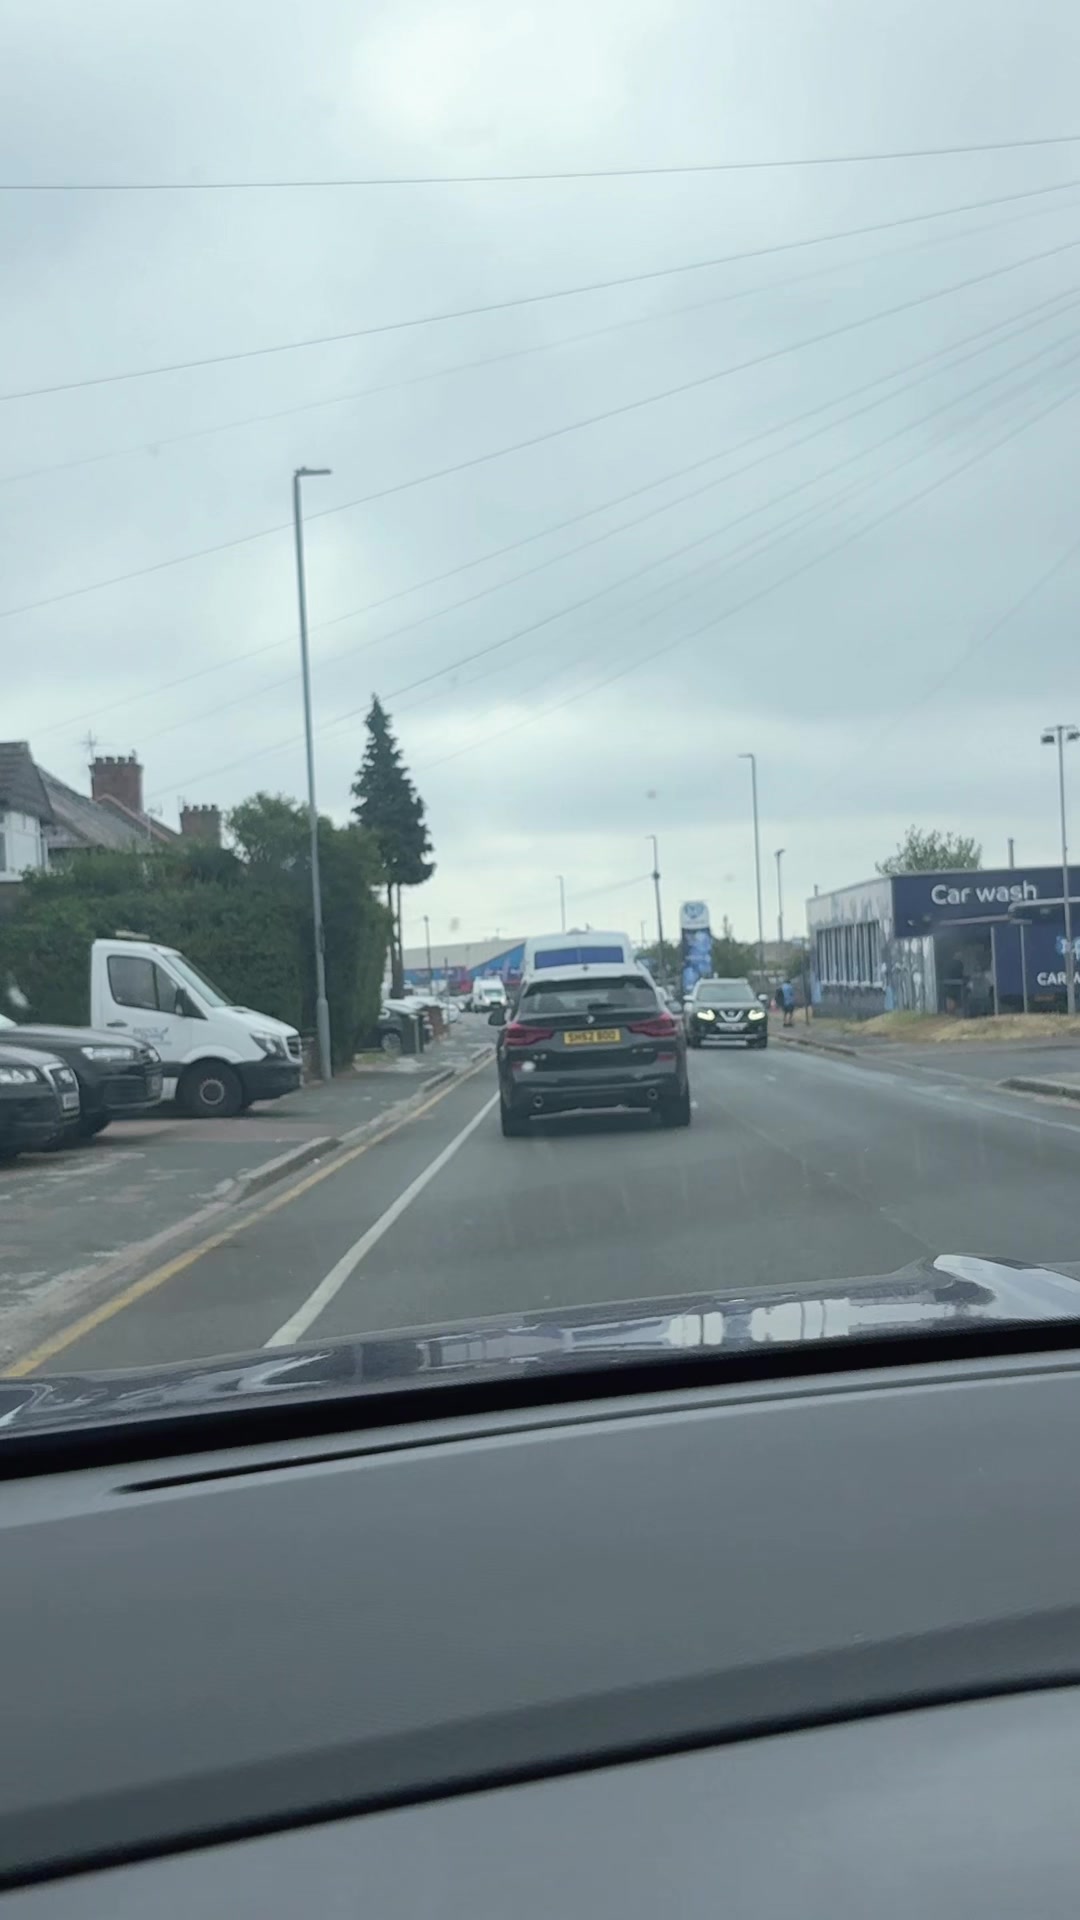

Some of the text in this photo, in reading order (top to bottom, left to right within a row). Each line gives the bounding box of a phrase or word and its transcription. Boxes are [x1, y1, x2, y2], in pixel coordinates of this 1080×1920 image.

[931, 879, 1038, 906] Car wash
[1036, 971, 1067, 987] CAR
